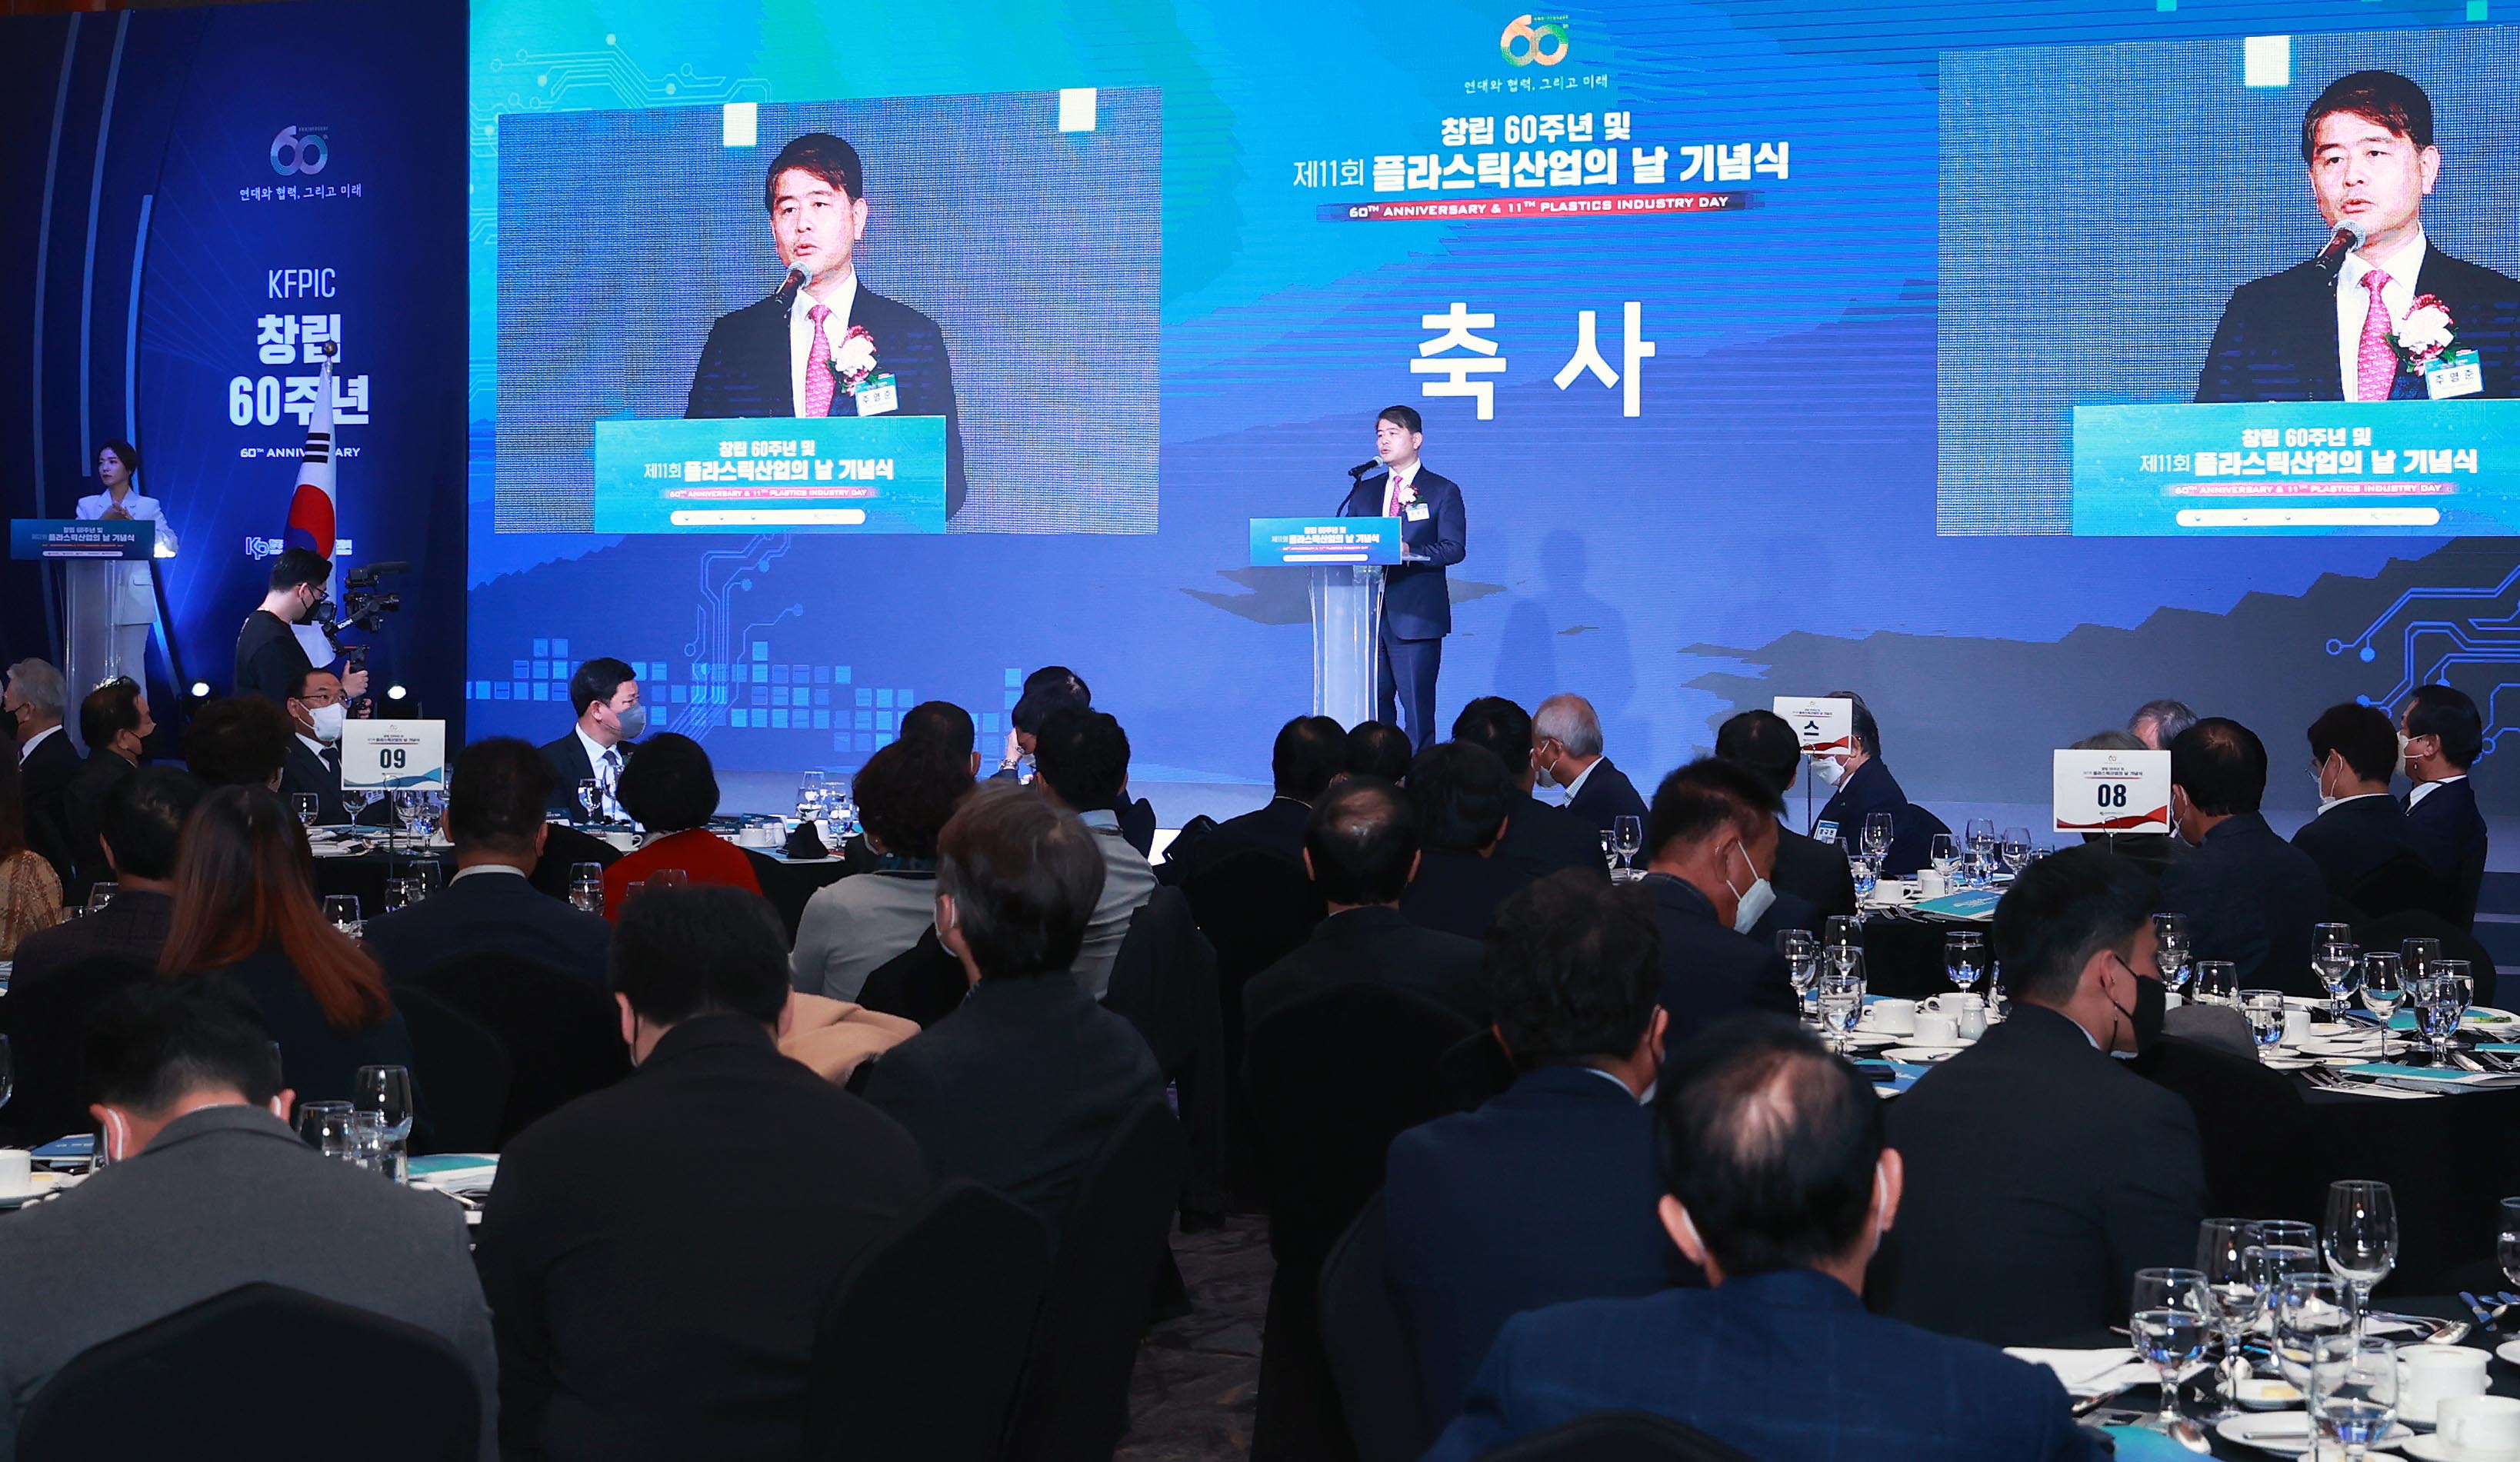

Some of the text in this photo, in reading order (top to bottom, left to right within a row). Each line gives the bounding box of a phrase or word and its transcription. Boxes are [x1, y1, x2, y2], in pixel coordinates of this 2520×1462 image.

[1464, 74, 1608, 94] 연대와 협력, 그리고 미래
[1441, 111, 1631, 146] 창립 60주년 및
[1293, 141, 1790, 191] 제11회 플라스틱산업의 날 기념식
[239, 185, 272, 201] 연대와
[303, 184, 337, 199] 그리고
[340, 183, 362, 198] 미래
[1383, 203, 1486, 217] ANNIVERSARY
[1490, 204, 1501, 214] &
[1540, 201, 1612, 212] PLASTICS
[1617, 197, 1694, 210] INDUSTRY
[1698, 195, 1729, 208] DAY
[268, 267, 337, 299] KFPIC
[257, 314, 341, 365] 창립
[2242, 426, 2372, 448] 창립 60주년 및
[719, 441, 748, 458] 창립
[751, 439, 797, 457] 60주년
[644, 458, 894, 481] 제11회 플라스틱산업의 날 기념식
[2139, 448, 2478, 476] 제11회 플라스틱산업의 날 기념식
[2200, 485, 2272, 494] ANNIVERSARY
[2310, 484, 2361, 493] PLASTICS
[2364, 483, 2417, 493] INDUSTRY
[2420, 483, 2442, 492] DAY
[380, 748, 406, 769] 09
[2098, 784, 2127, 808] 08
